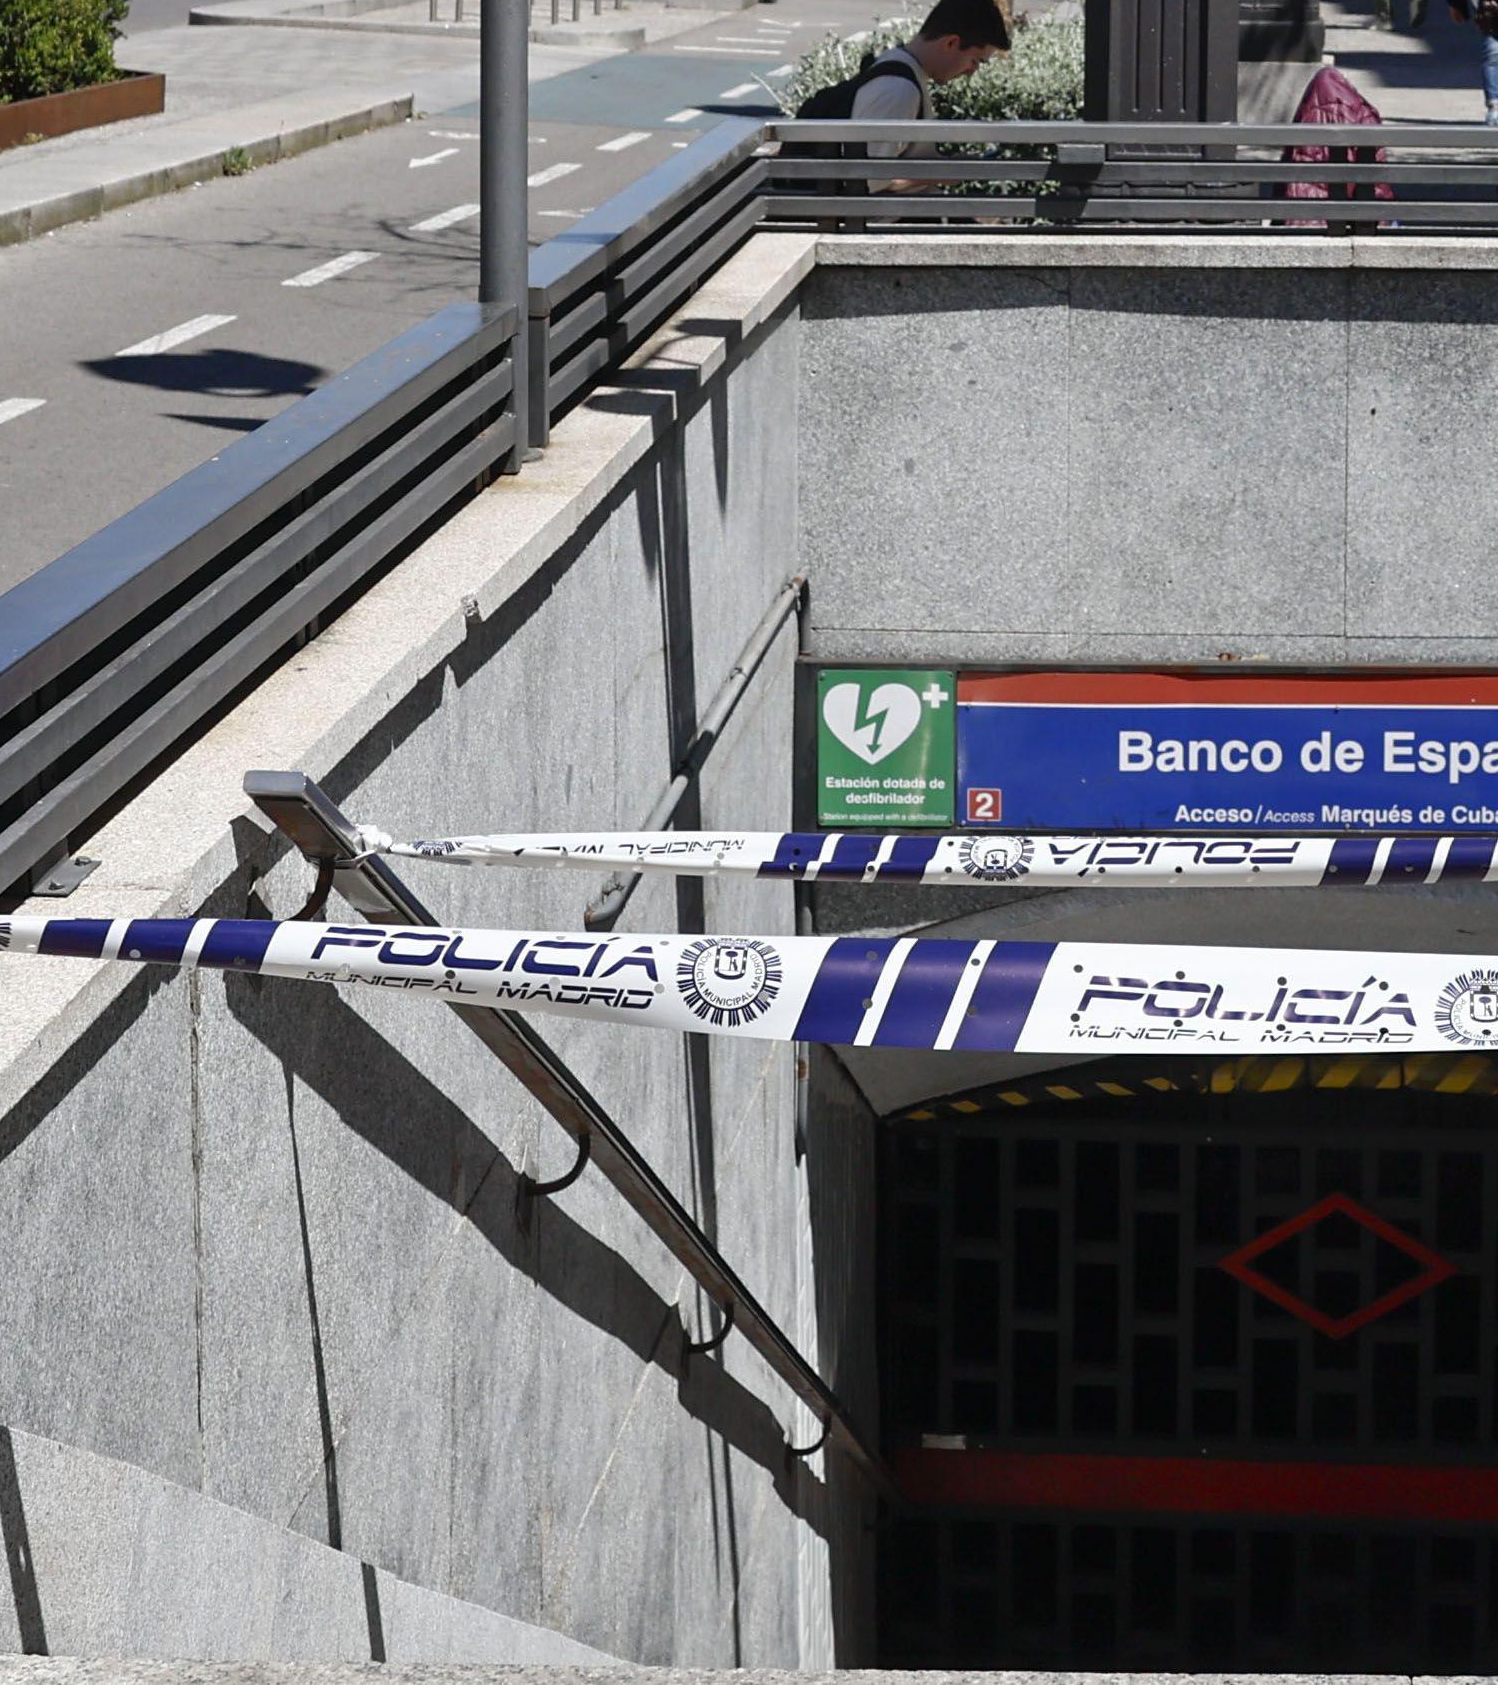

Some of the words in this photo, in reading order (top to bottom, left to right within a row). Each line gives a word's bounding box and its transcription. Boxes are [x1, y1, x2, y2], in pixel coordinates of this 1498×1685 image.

[1118, 730, 1283, 773] Banco
[1300, 730, 1365, 774] de
[825, 776, 880, 789] Estación
[883, 777, 926, 789] dotada
[929, 777, 946, 789] de
[845, 792, 927, 805] desfibrilador
[974, 792, 994, 817] 2
[1320, 803, 1414, 828] Marqués
[1418, 805, 1446, 824] de
[309, 925, 660, 983] POLICÍA
[305, 970, 478, 995] MUNICIPAL
[495, 980, 655, 1009] MADRID
[702, 987, 755, 1008] MUNICIPAL
[1076, 974, 1418, 1028] POLICÍA
[1068, 1024, 1241, 1043] MUNICIPAL
[1259, 1028, 1415, 1045] MADRID
